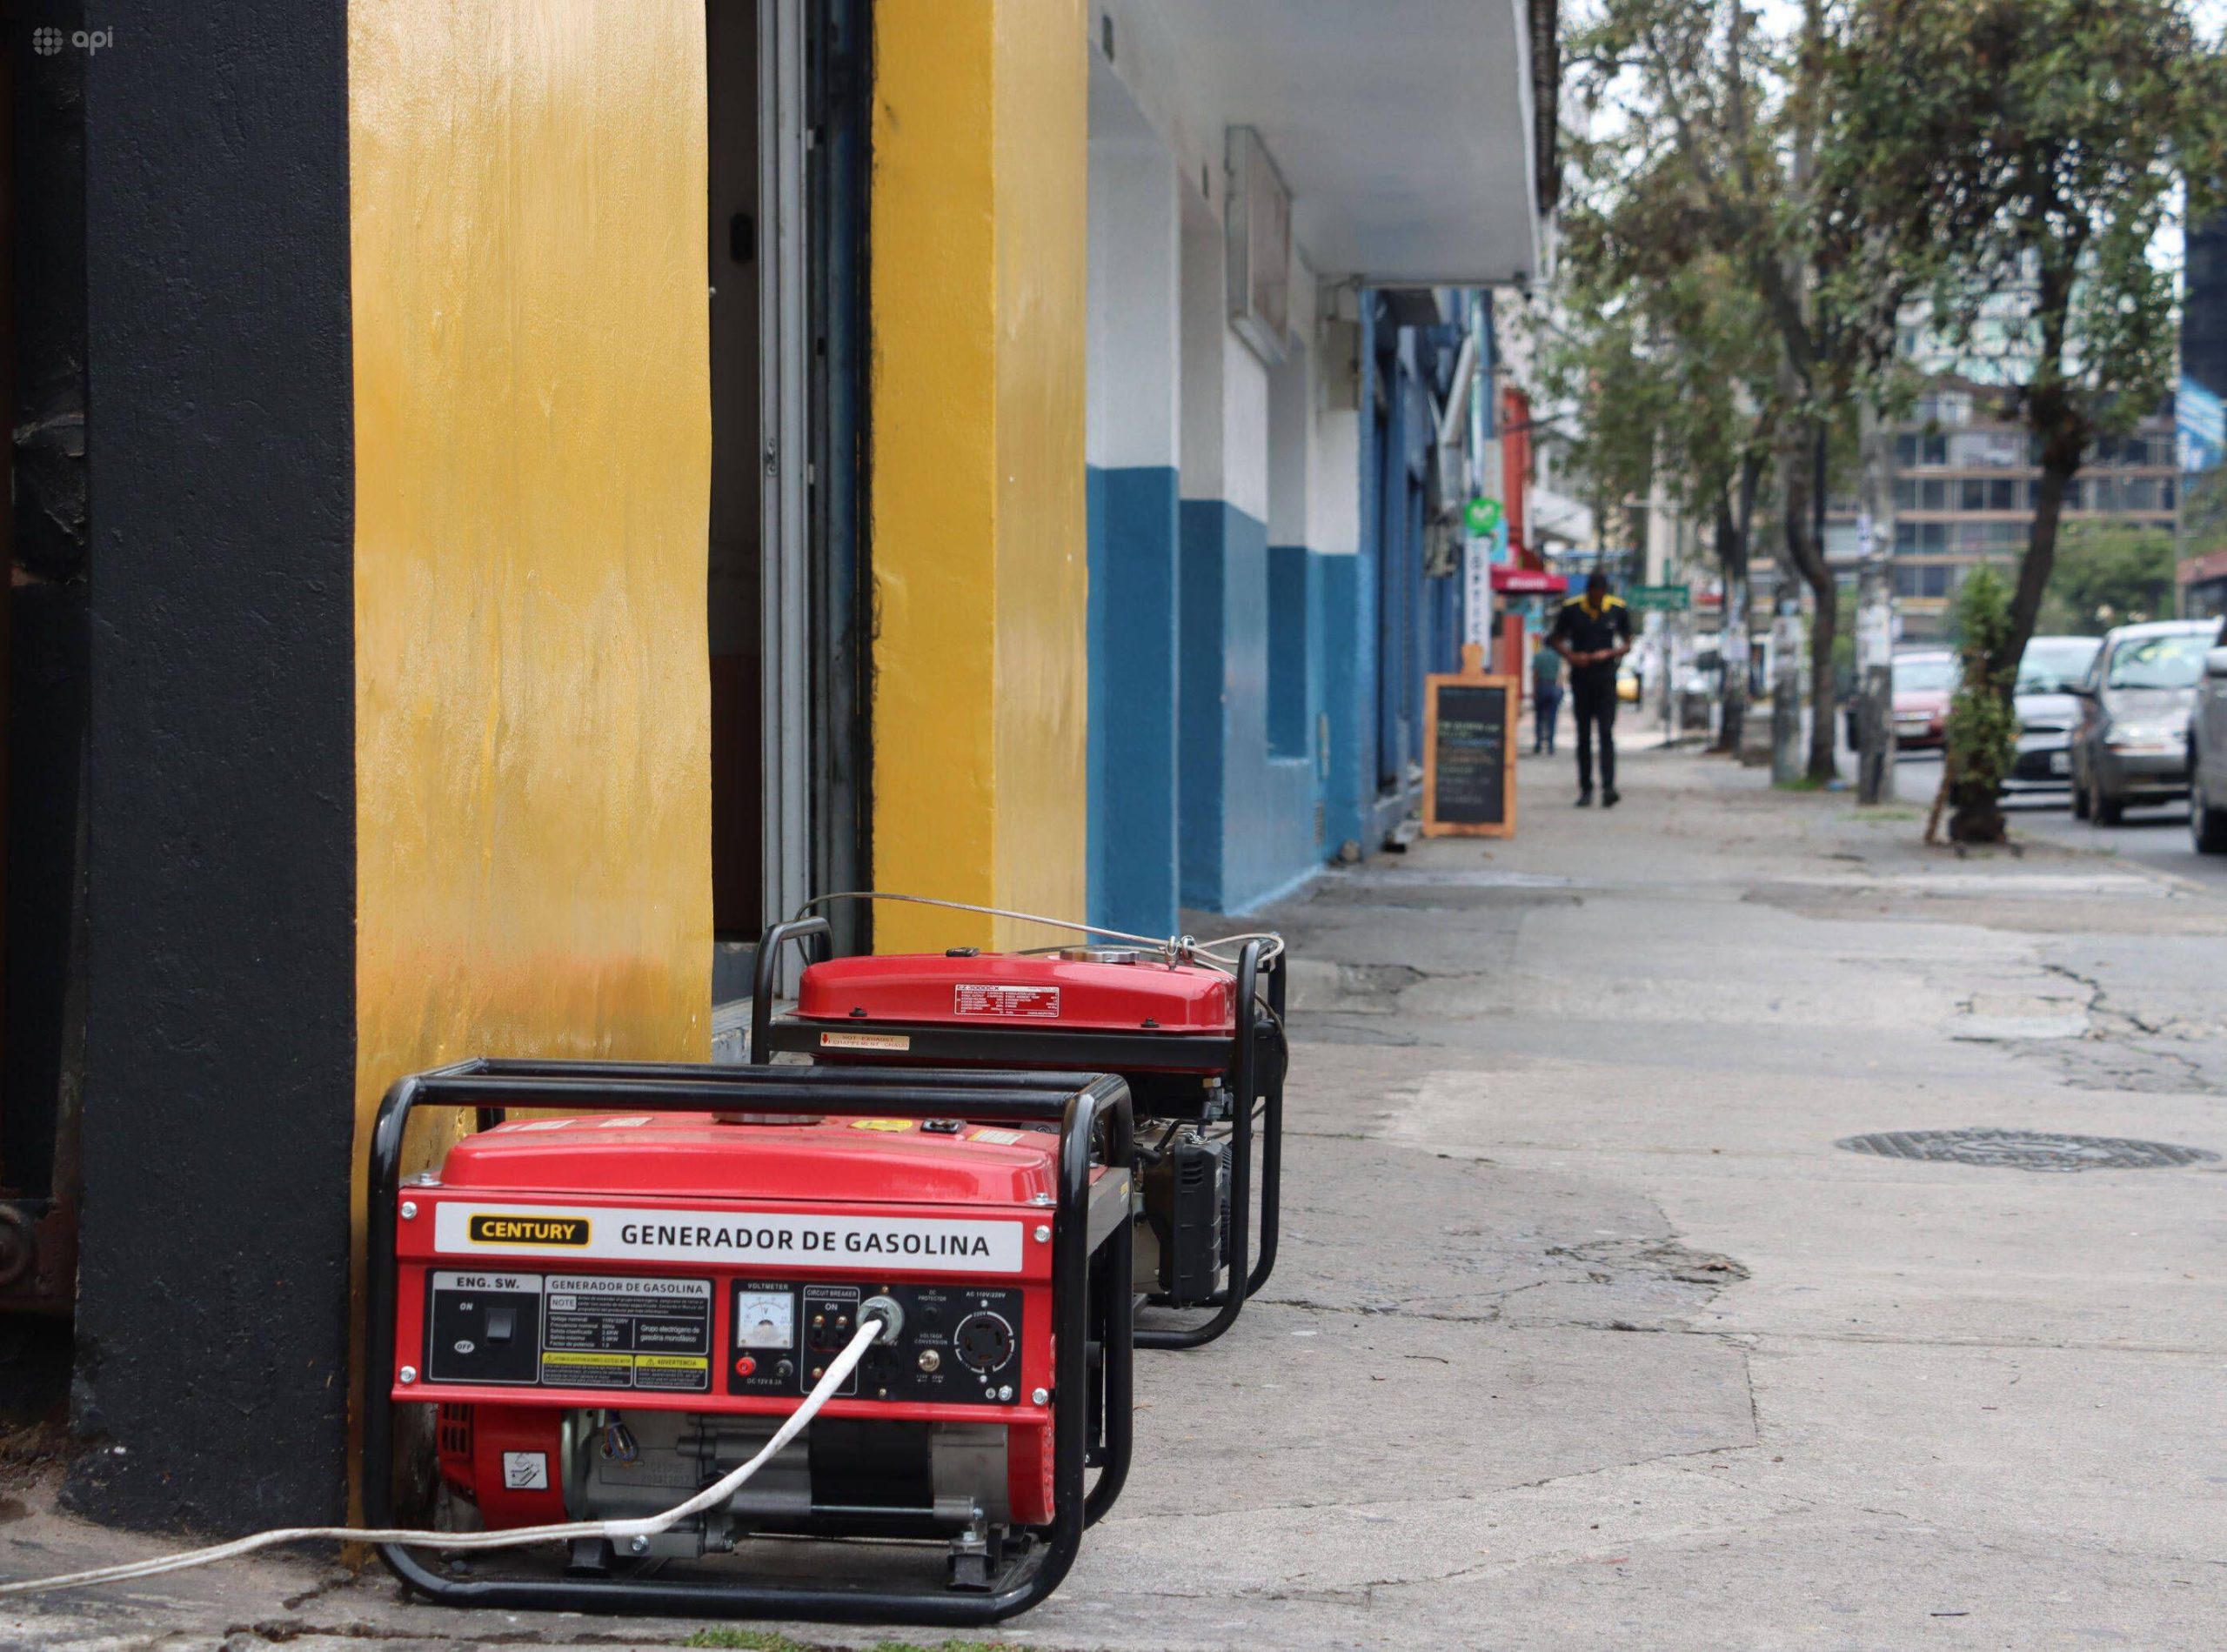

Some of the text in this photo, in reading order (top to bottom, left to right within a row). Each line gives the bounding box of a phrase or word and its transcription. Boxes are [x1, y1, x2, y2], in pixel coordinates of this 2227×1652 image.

[481, 1221, 576, 1241] CENTURY
[621, 1223, 990, 1257] GENERADOR DE GASOLINA
[457, 1277, 519, 1289] ENG. SW.
[552, 1280, 703, 1294] GENERADOR DE GASOLINA
[459, 1302, 473, 1311] ON
[552, 1298, 573, 1307] NOTE
[640, 1324, 659, 1333] Grupo
